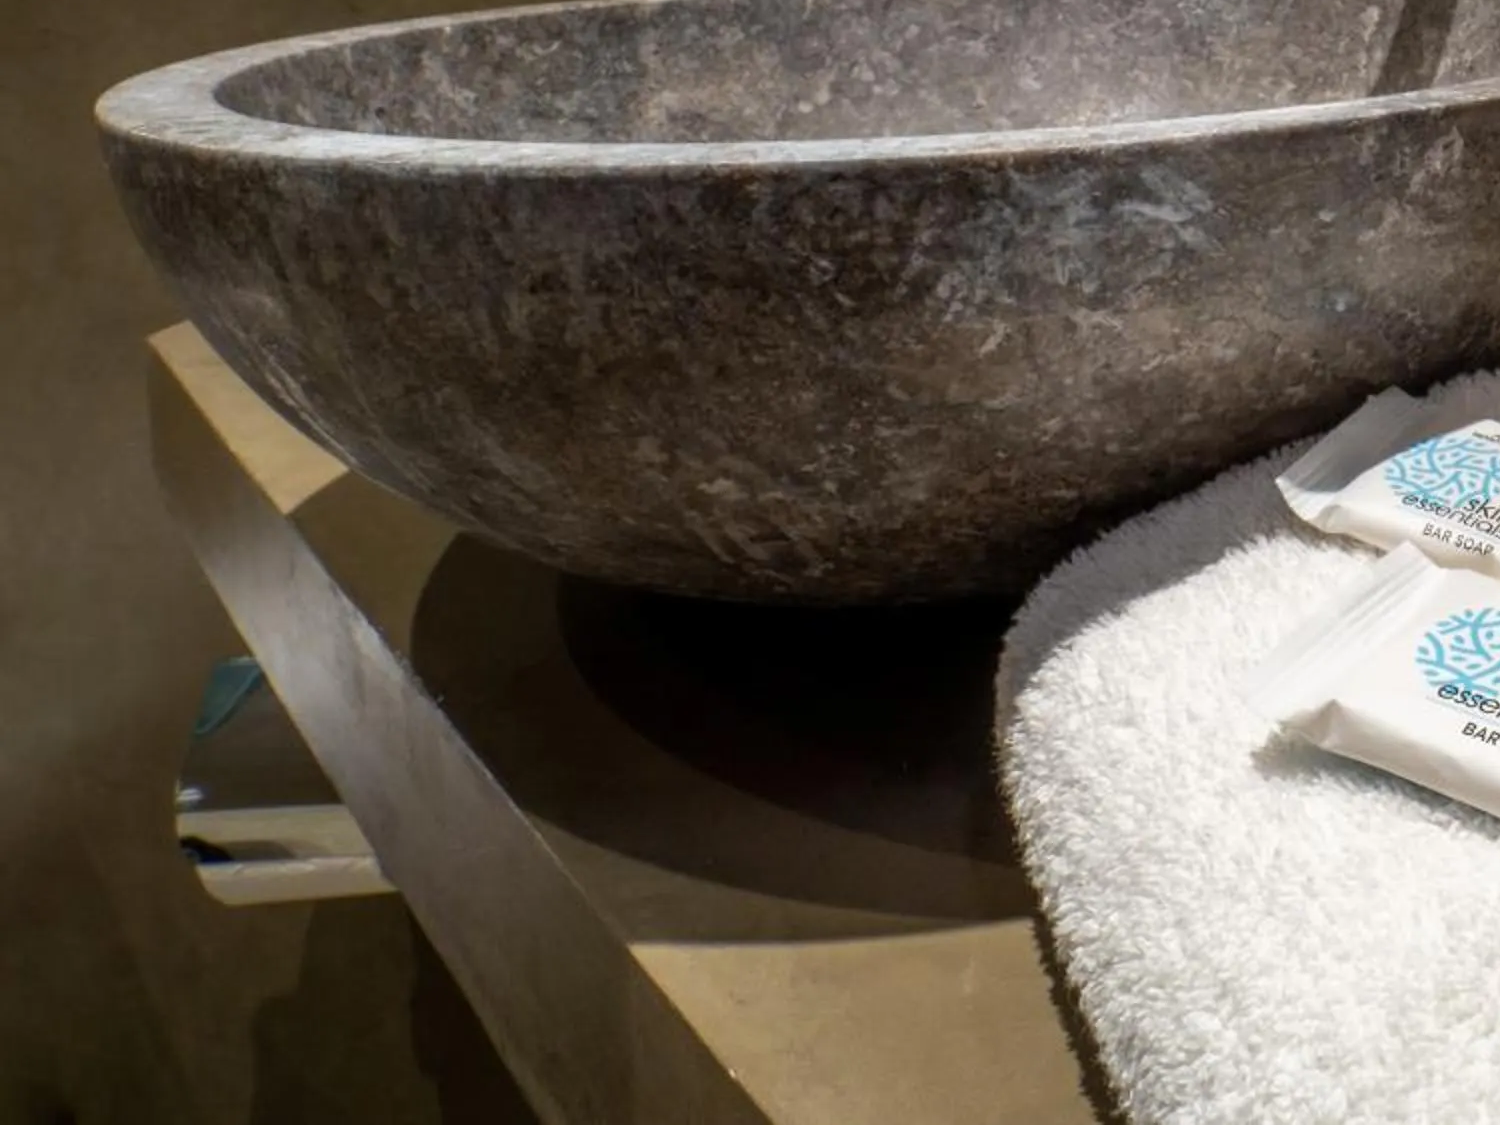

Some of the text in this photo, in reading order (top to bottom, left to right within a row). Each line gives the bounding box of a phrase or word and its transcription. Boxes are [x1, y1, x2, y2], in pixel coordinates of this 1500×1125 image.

[1422, 523, 1494, 557] BAR SOAP
[1461, 722, 1500, 746] BAR
